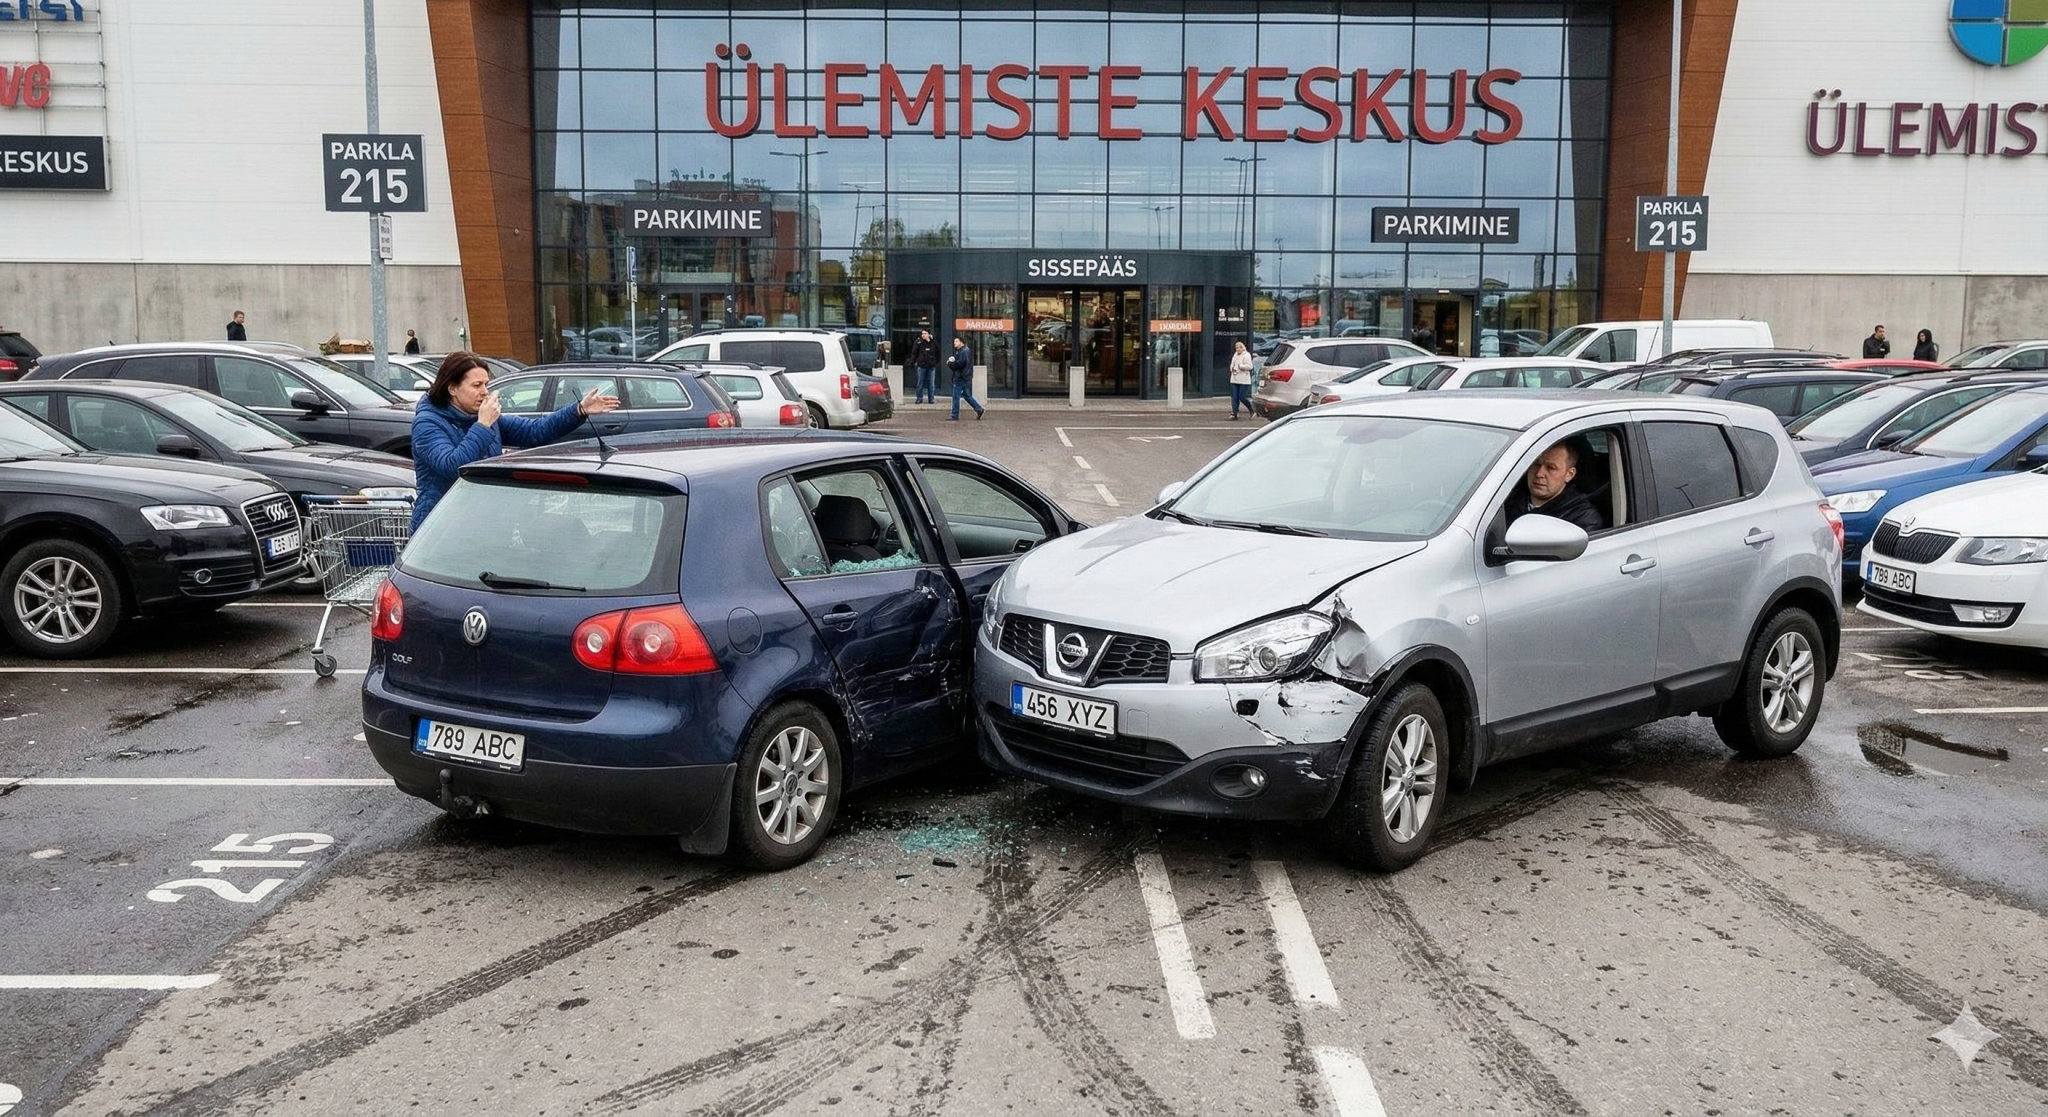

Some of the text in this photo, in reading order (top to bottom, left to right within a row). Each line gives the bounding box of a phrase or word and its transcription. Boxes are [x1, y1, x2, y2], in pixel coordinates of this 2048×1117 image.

[705, 43, 1523, 145] ÜLEMISTE KESKUS
[1806, 87, 2048, 157] ÜLEMIS
[331, 141, 415, 161] PARKLA
[340, 168, 408, 204] 215
[634, 209, 762, 230] PARKIMINE
[1643, 201, 1703, 216] PARKLA
[1384, 215, 1510, 236] PARKIMINE
[1649, 220, 1697, 246] 215
[1028, 255, 1138, 278] SISSEPÄÄS
[1891, 571, 1912, 590] ABC
[1027, 691, 1058, 719] 456
[1067, 699, 1107, 730] XYZ
[433, 724, 517, 761] 789 ABC
[146, 832, 335, 903] 215
